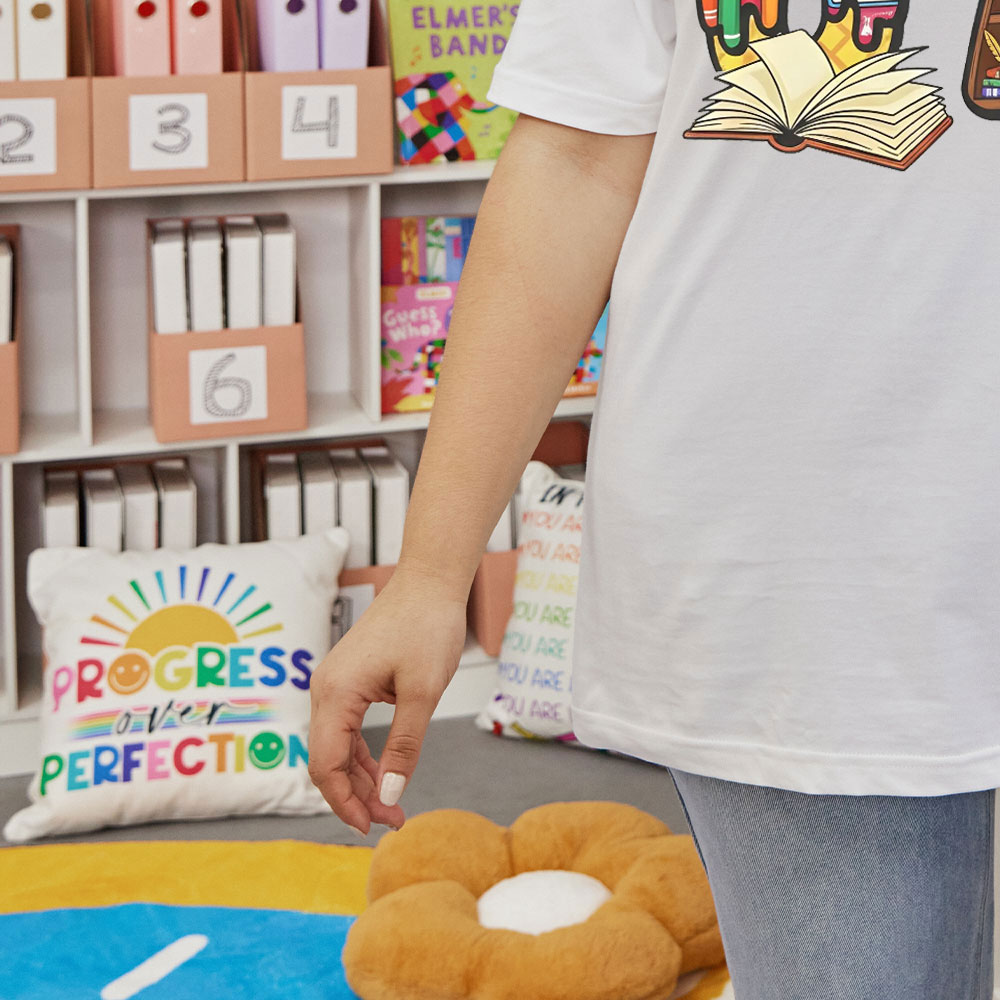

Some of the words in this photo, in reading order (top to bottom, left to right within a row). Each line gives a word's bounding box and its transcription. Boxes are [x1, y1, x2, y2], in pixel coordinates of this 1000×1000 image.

[429, 34, 508, 59] BAND
[0, 113, 34, 164] 2
[152, 102, 192, 155] 3
[290, 95, 340, 149] 4
[383, 306, 437, 328] Guess
[388, 320, 442, 343] Who?
[203, 352, 254, 418] 6
[52, 645, 314, 713] PROGRESS
[116, 699, 234, 734] over
